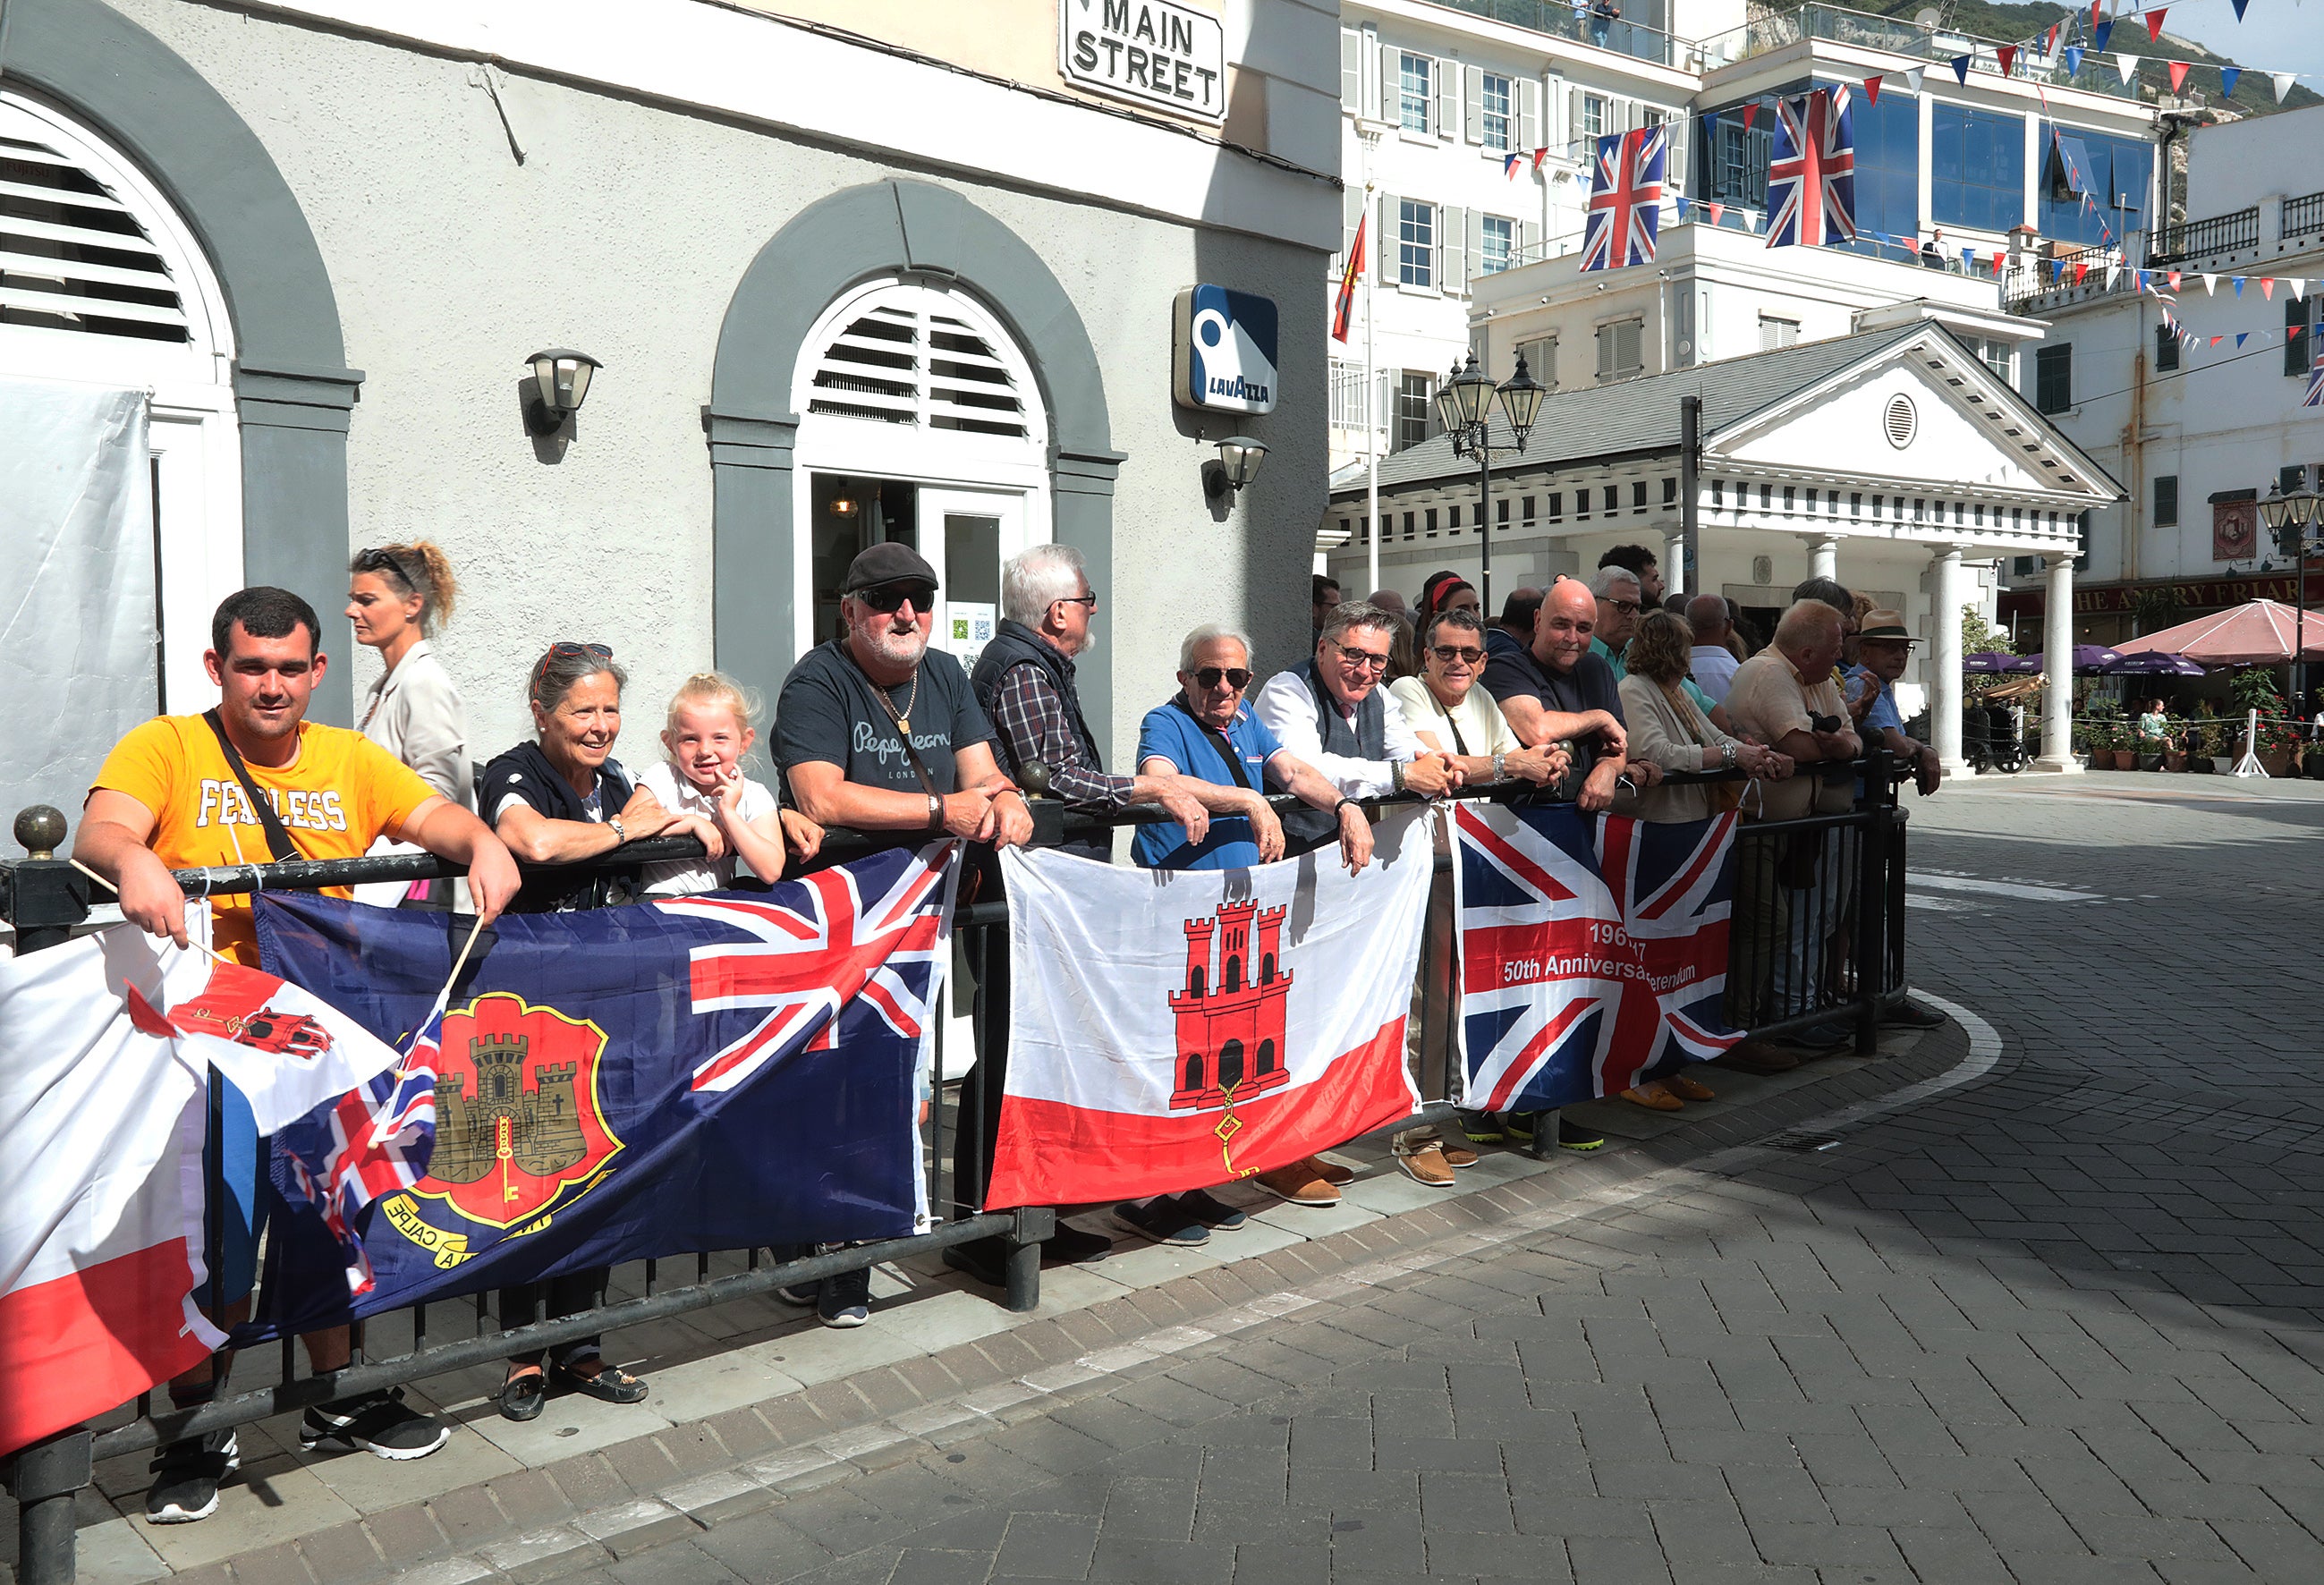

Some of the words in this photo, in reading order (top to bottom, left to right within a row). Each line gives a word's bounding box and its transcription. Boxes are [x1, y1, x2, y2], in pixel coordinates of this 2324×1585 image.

[1101, 0, 1192, 56] MAIN
[1073, 30, 1217, 106] STREET
[1209, 375, 1269, 403] LAVAZZA
[2075, 590, 2109, 611] HE
[2214, 579, 2298, 603] FRIAR
[853, 721, 902, 765] Pepe
[888, 767, 934, 779] LONDN
[196, 778, 348, 832] FEALESS
[1503, 954, 1540, 983] 50th
[1544, 953, 1646, 981] Anniversa
